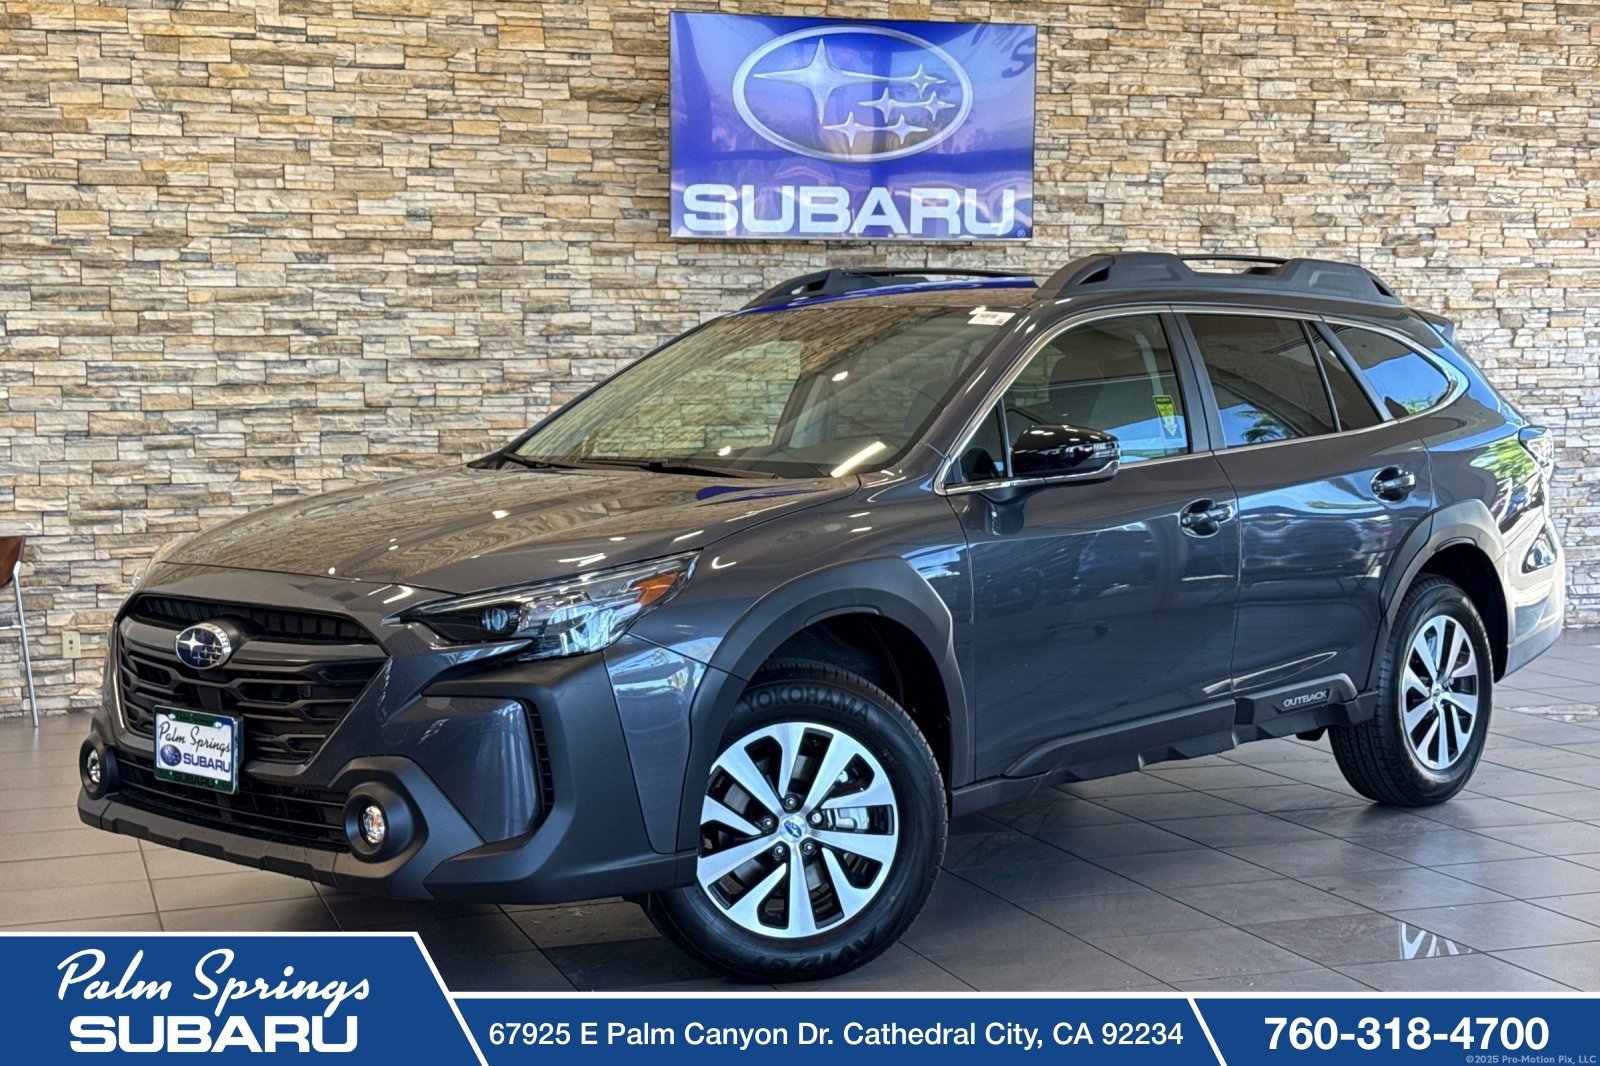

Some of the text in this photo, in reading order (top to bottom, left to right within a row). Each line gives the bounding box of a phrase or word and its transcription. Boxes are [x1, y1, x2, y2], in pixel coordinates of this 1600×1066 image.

[683, 183, 1015, 235] SUBARU
[740, 685, 869, 721] YOKOHAMA
[1283, 689, 1327, 708] OUTBACK
[159, 720, 231, 757] Palm Springs
[183, 752, 231, 773] SUBARU
[173, 771, 215, 788] SUBARU
